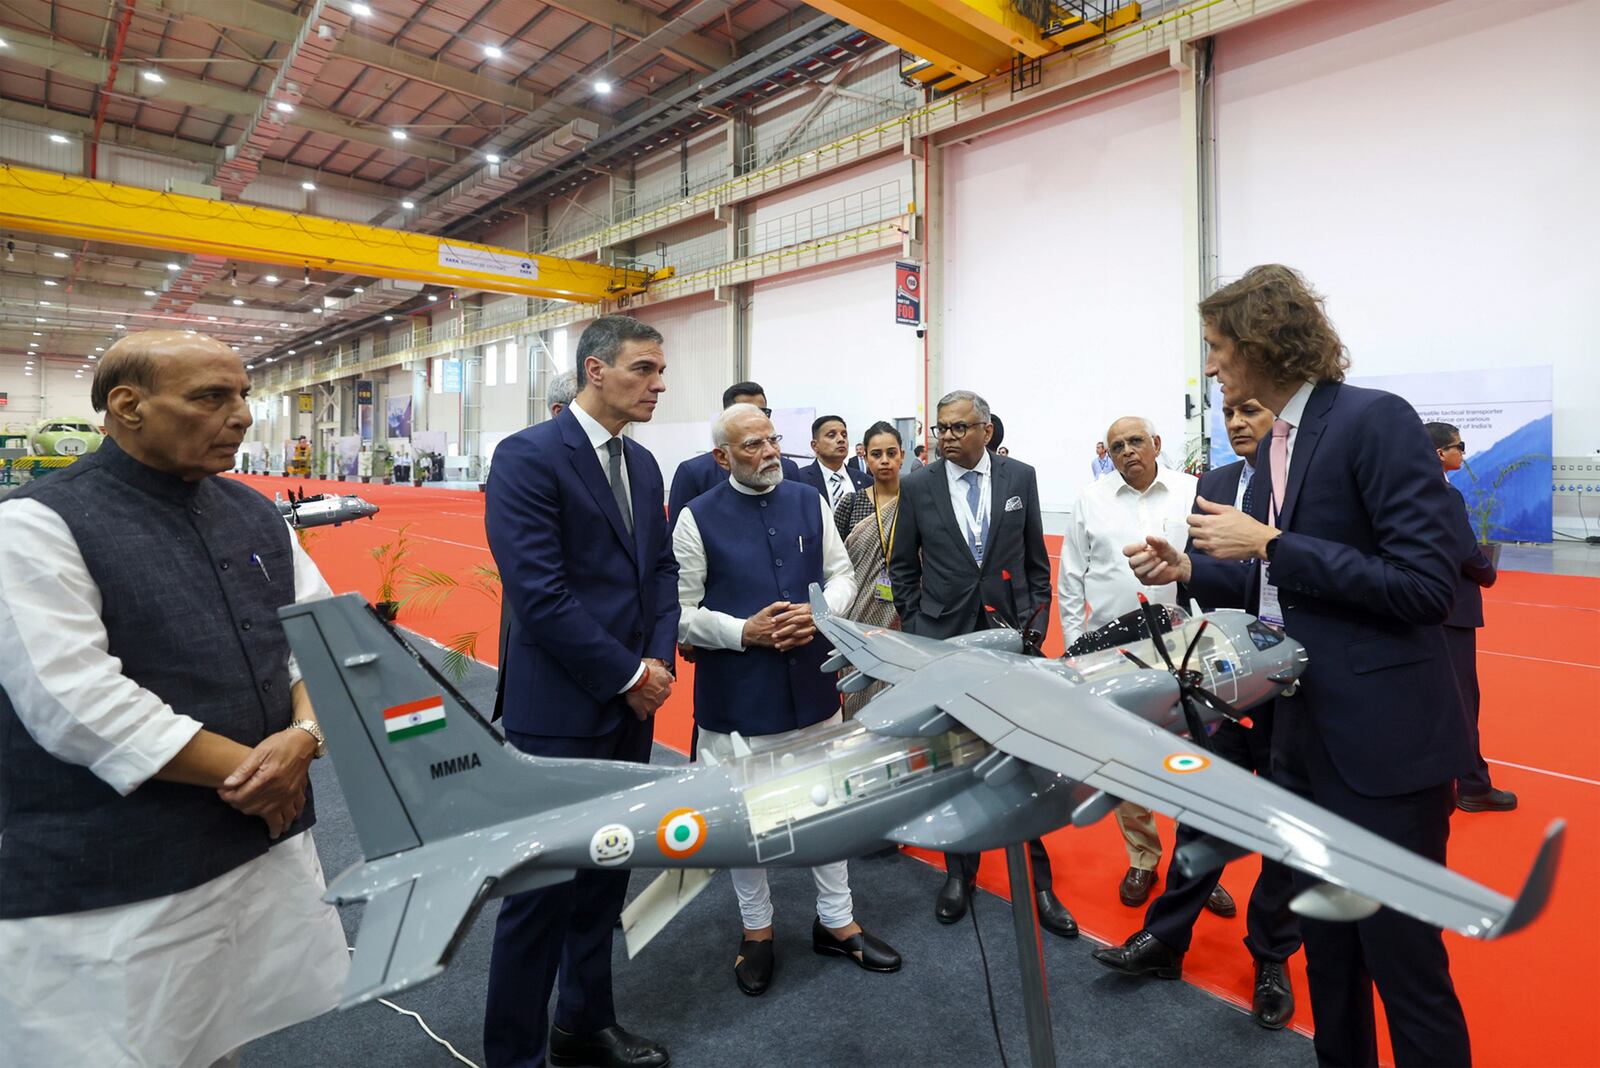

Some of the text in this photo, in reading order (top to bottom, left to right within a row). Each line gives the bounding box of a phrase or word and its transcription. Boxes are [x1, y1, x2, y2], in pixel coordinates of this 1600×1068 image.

[897, 304, 915, 319] FOD
[1466, 408, 1503, 416] transporter
[430, 752, 482, 780] MMMA
